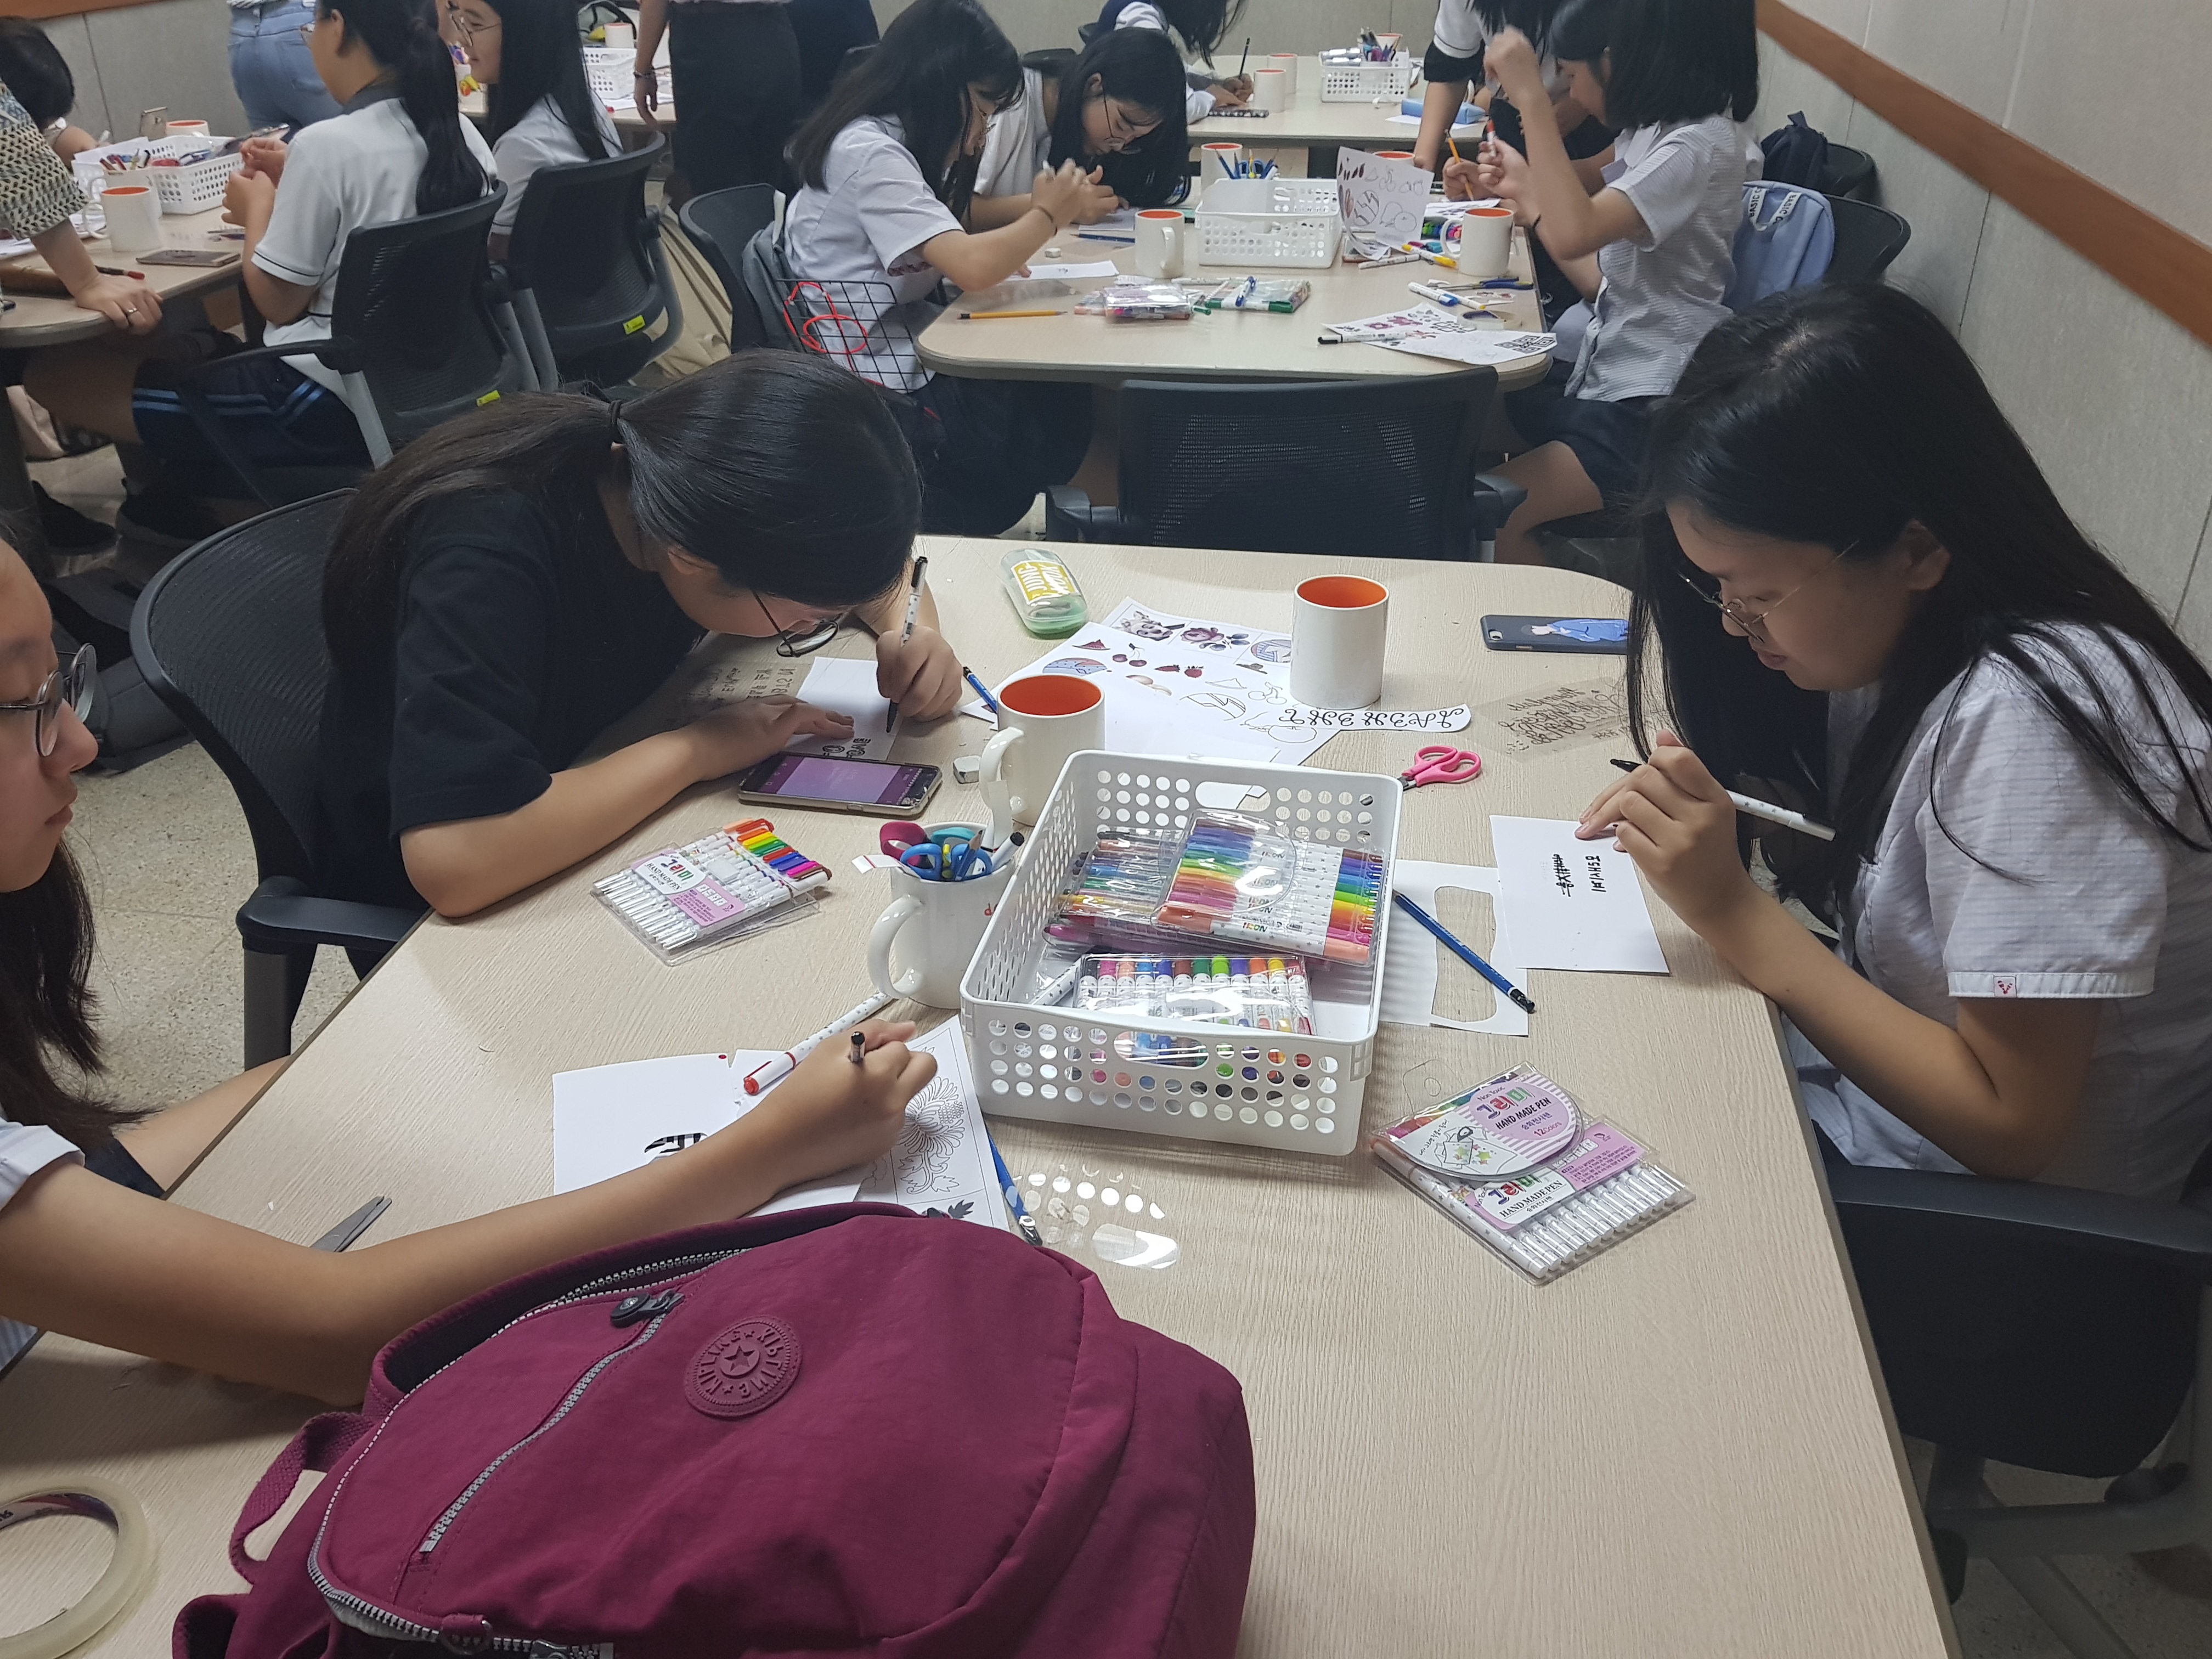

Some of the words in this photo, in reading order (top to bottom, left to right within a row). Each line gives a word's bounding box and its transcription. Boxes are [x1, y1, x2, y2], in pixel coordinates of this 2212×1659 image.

[1018, 563, 1047, 593] JUNG
[1243, 922, 1268, 932] IRON
[1477, 1086, 1536, 1120] 그리미
[1495, 1115, 1516, 1130] HAND
[1515, 1105, 1537, 1120] MADE
[1535, 1097, 1552, 1110] PEN
[1488, 1174, 1542, 1205] 그리미
[1499, 1202, 1524, 1217] HAND
[1523, 1189, 1547, 1205] MADE
[1545, 1180, 1563, 1193] PEN
